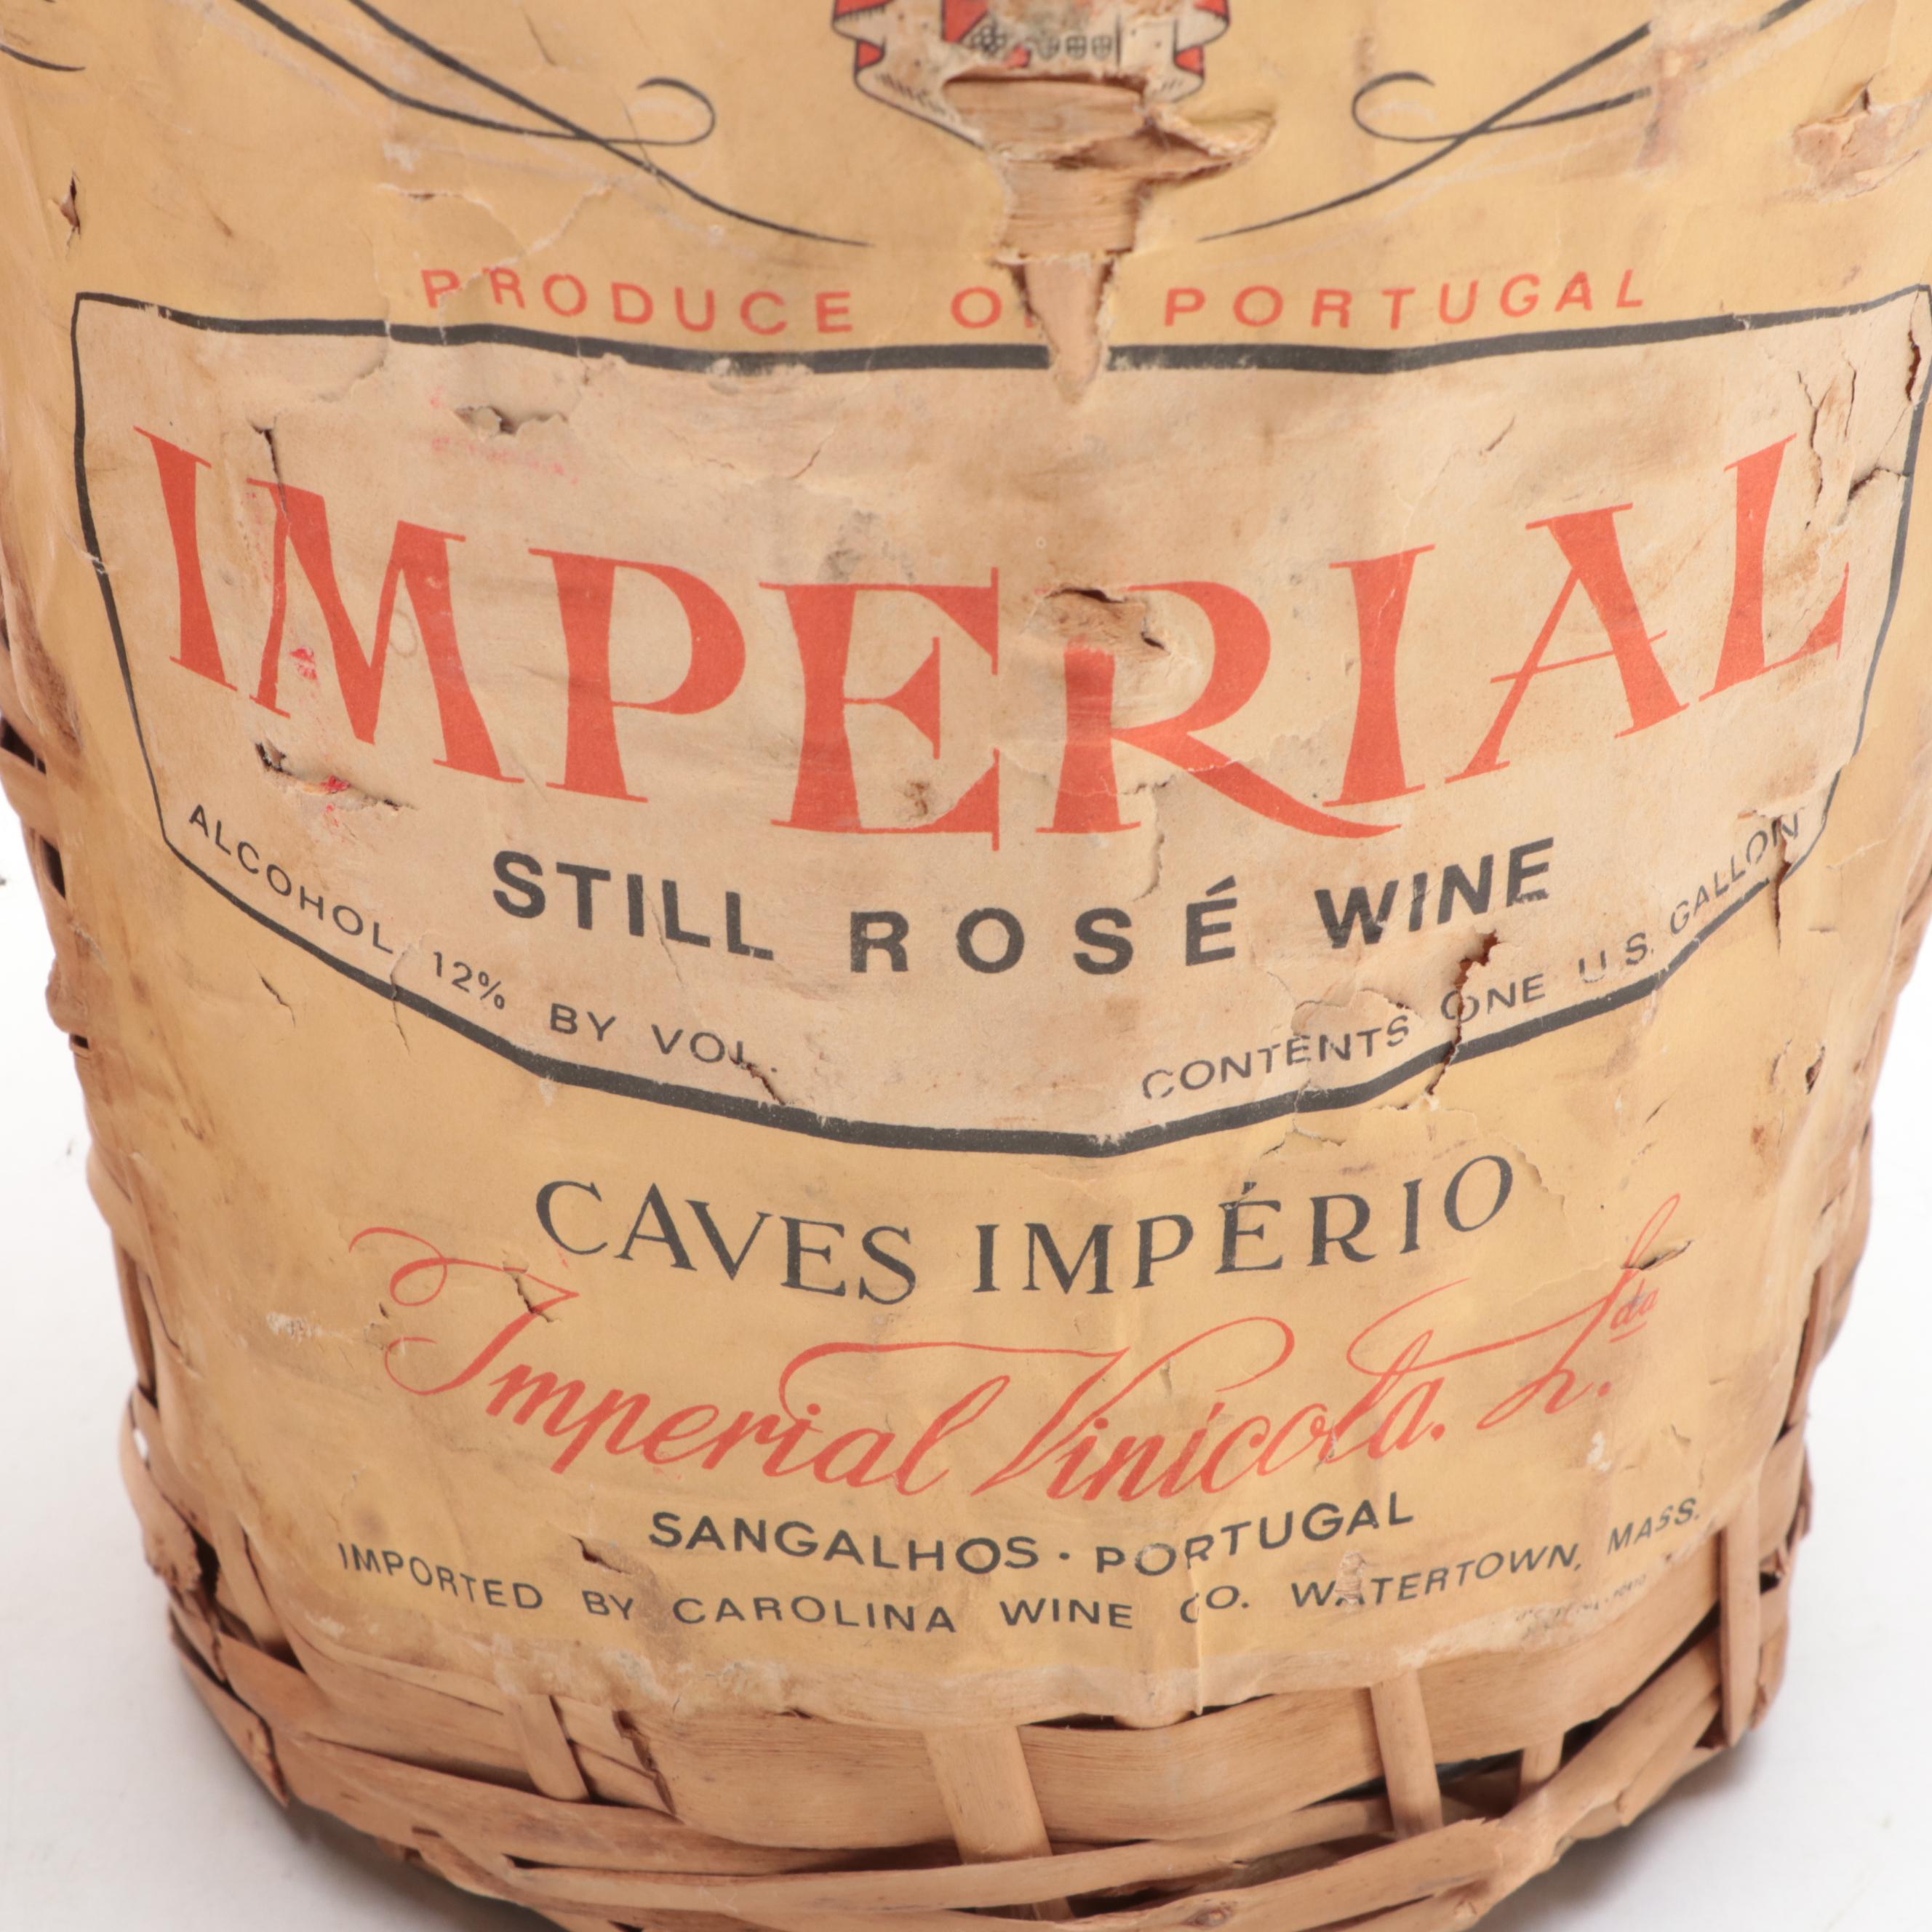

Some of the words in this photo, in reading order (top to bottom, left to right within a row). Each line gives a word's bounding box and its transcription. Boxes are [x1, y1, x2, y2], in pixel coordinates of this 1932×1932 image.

[420, 267, 854, 335] PRODUCE
[950, 286, 1036, 330] O
[1164, 268, 1644, 330] PORTUGAL
[133, 426, 1849, 852] IMPERIAL
[188, 804, 395, 954] ALCOHOL
[432, 951, 506, 1012] 12%
[550, 1002, 617, 1042] BY
[493, 850, 774, 960] STILL
[850, 875, 1237, 975] ROSÉ
[1314, 837, 1554, 949] WINE
[1141, 1014, 1410, 1101] CONTENTS
[1440, 973, 1546, 1023] ONE
[1669, 812, 1800, 935] GALLON
[535, 1180, 917, 1305] CAVES
[973, 1154, 1513, 1294] IMPÉRIO
[348, 1226, 1011, 1496] Imperial
[338, 1543, 543, 1610] IMPORTED
[582, 1589, 634, 1621] BY
[672, 1596, 957, 1633] CAROLINA
[999, 1597, 1133, 1629] WINE
[1180, 1584, 1250, 1624] CO.
[1290, 1543, 1582, 1608] WTERTOWN,
[1607, 1496, 1701, 1557] MASS.
[648, 1510, 1039, 1575] SANGALHOS
[1095, 1491, 1415, 1577] PORTUGAL
